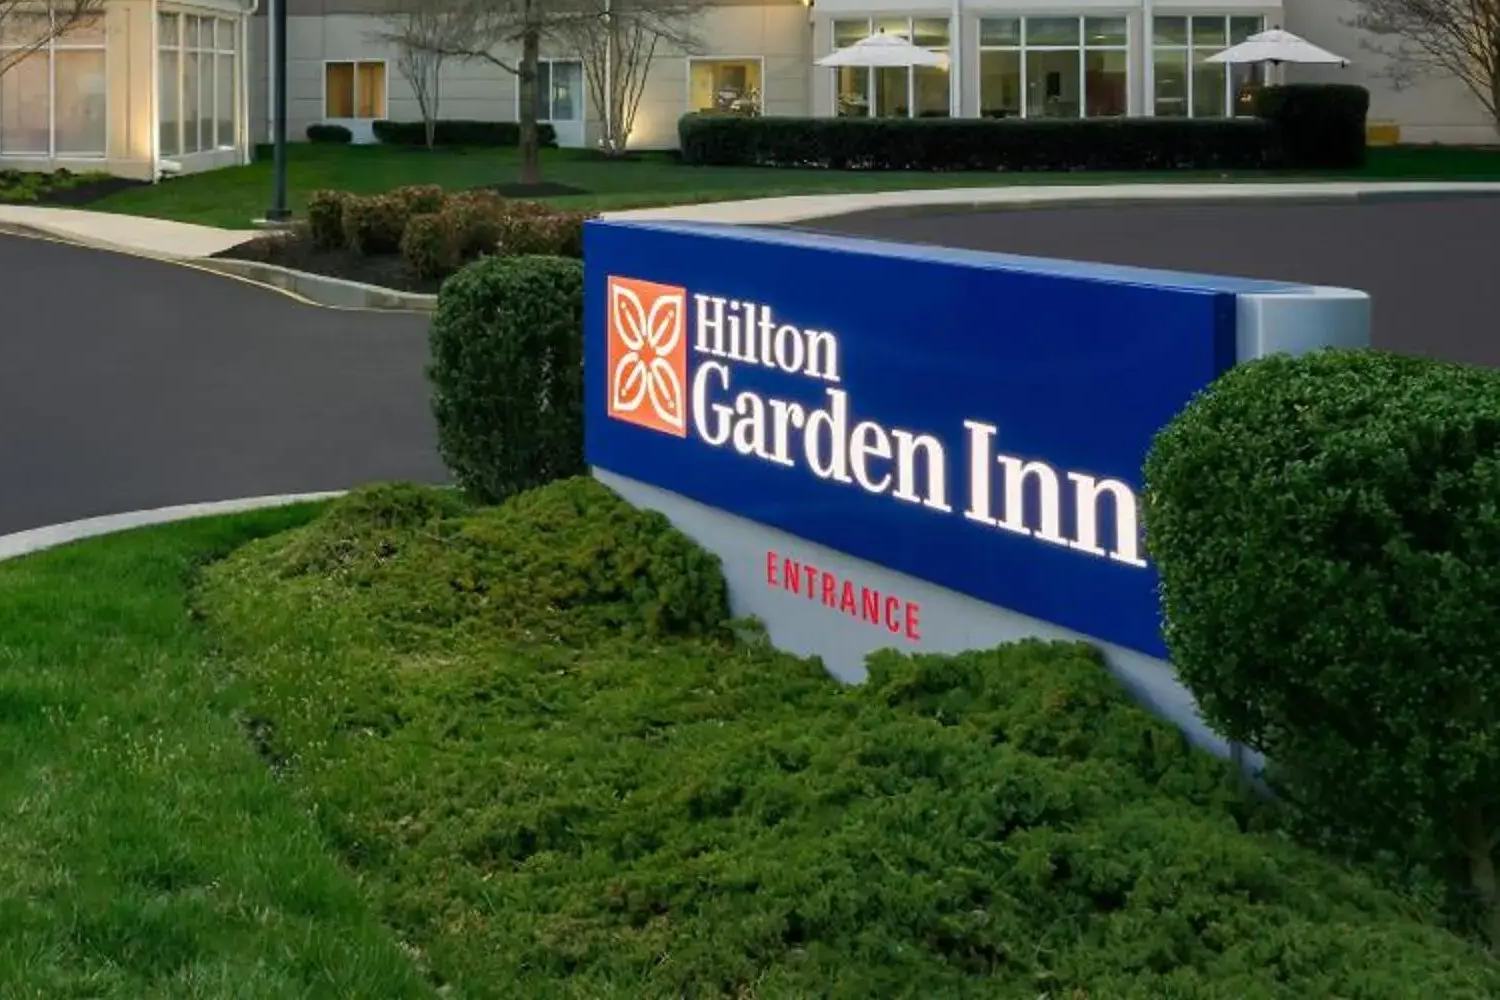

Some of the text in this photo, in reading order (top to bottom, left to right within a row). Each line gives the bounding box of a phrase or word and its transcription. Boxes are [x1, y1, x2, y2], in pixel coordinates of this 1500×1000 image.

[693, 294, 840, 382] Hilton
[692, 360, 1148, 568] Garden Inn
[766, 550, 922, 641] ENTRANCE
